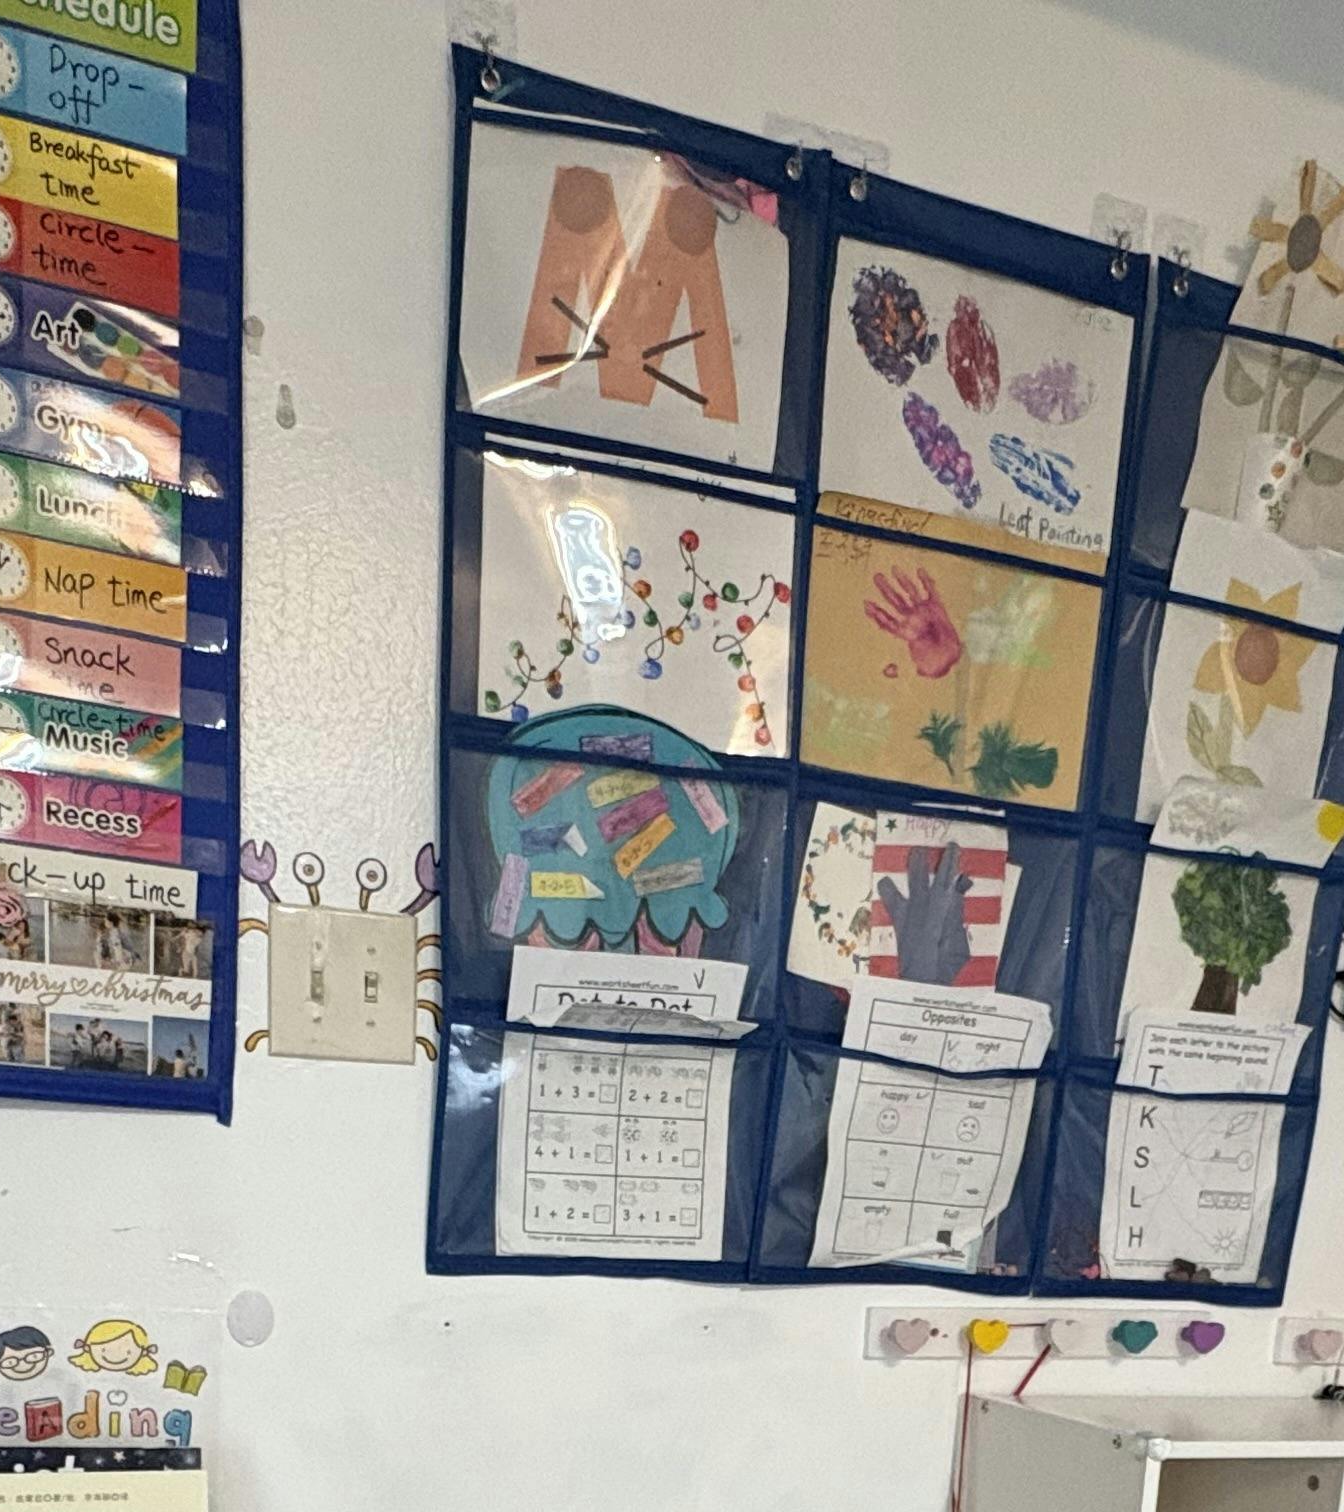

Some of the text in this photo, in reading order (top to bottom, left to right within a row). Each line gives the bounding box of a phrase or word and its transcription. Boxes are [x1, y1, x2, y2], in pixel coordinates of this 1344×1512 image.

[49, 84, 100, 123] off
[30, 131, 141, 180] Breakfast
[40, 172, 100, 206] time
[32, 243, 106, 286] time
[33, 311, 80, 347] Art
[36, 403, 102, 442] Gym
[998, 503, 1033, 538] Leaf
[44, 565, 167, 614] Nap time
[45, 637, 136, 676] Snack
[44, 724, 129, 759] Music
[44, 799, 141, 836] Recess
[126, 874, 186, 908] time
[88, 970, 212, 1012] christmas
[921, 1010, 977, 1028] Opposites
[899, 1031, 918, 1045] day
[1147, 1064, 1164, 1088] T
[1139, 1105, 1158, 1130] K
[1134, 1145, 1151, 1169] S
[864, 1203, 892, 1216] empty
[1130, 1184, 1142, 1209] L
[1127, 1225, 1144, 1249] H
